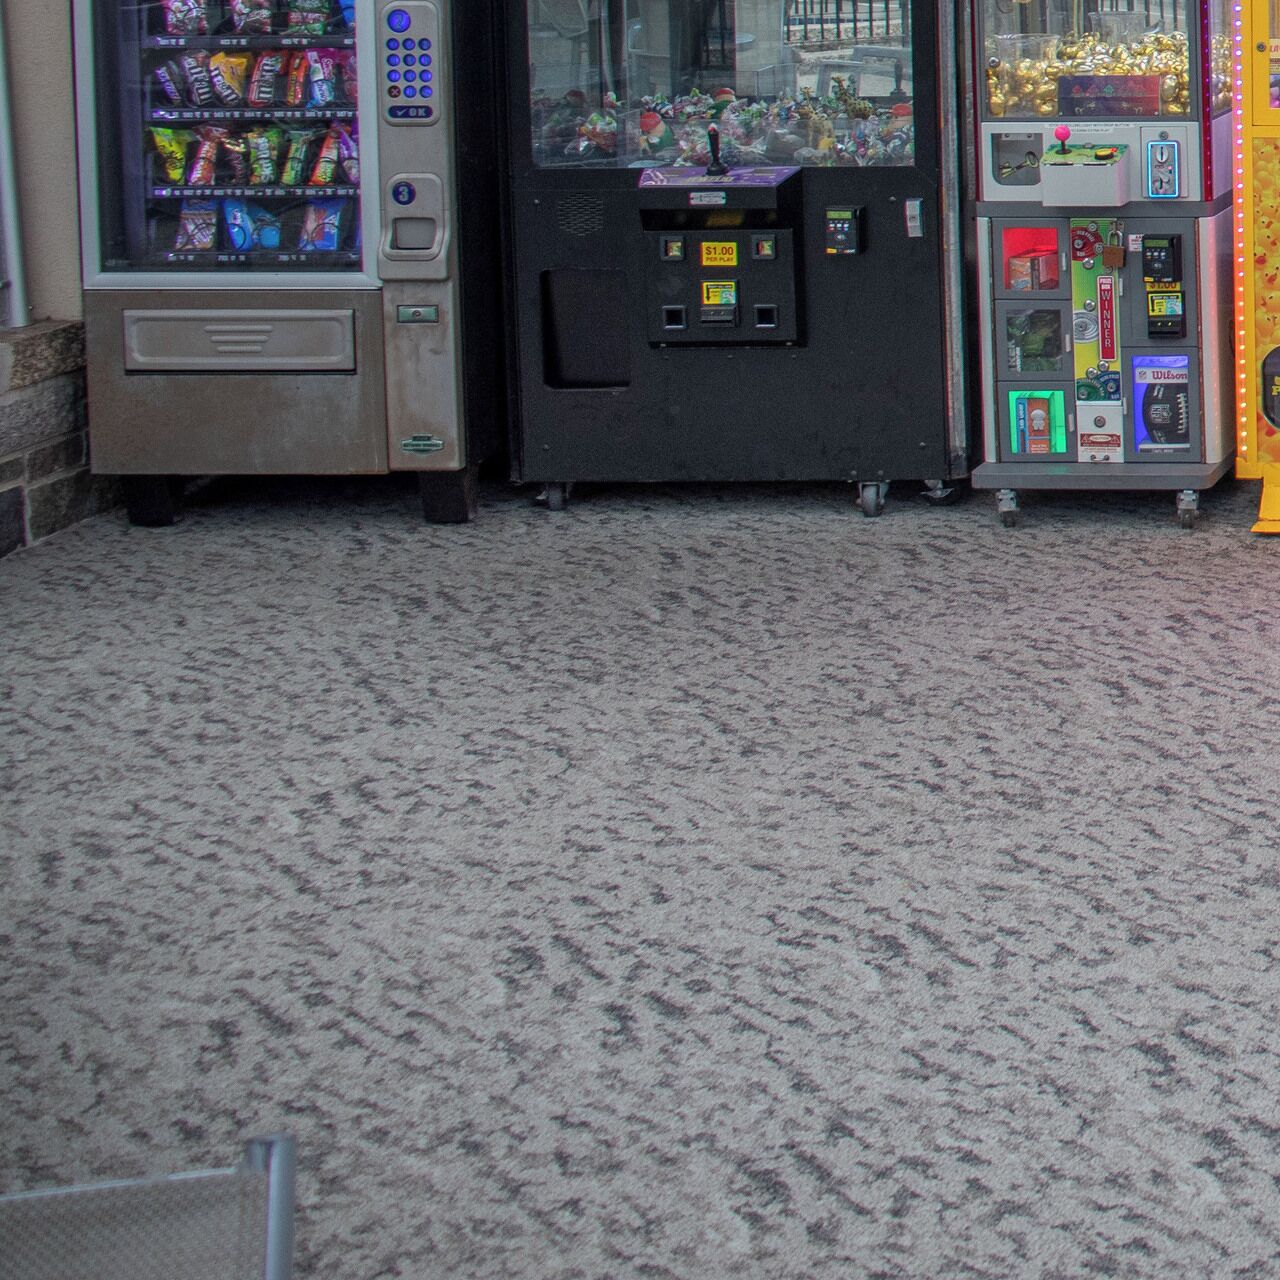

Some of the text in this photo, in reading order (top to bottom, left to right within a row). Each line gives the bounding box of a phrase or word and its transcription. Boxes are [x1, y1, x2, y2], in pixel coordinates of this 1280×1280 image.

[409, 108, 426, 116] OK
[399, 186, 408, 201] 3
[706, 247, 734, 256] $1.00
[1101, 291, 1112, 348] WINNER
[1152, 370, 1187, 380] Wilson
